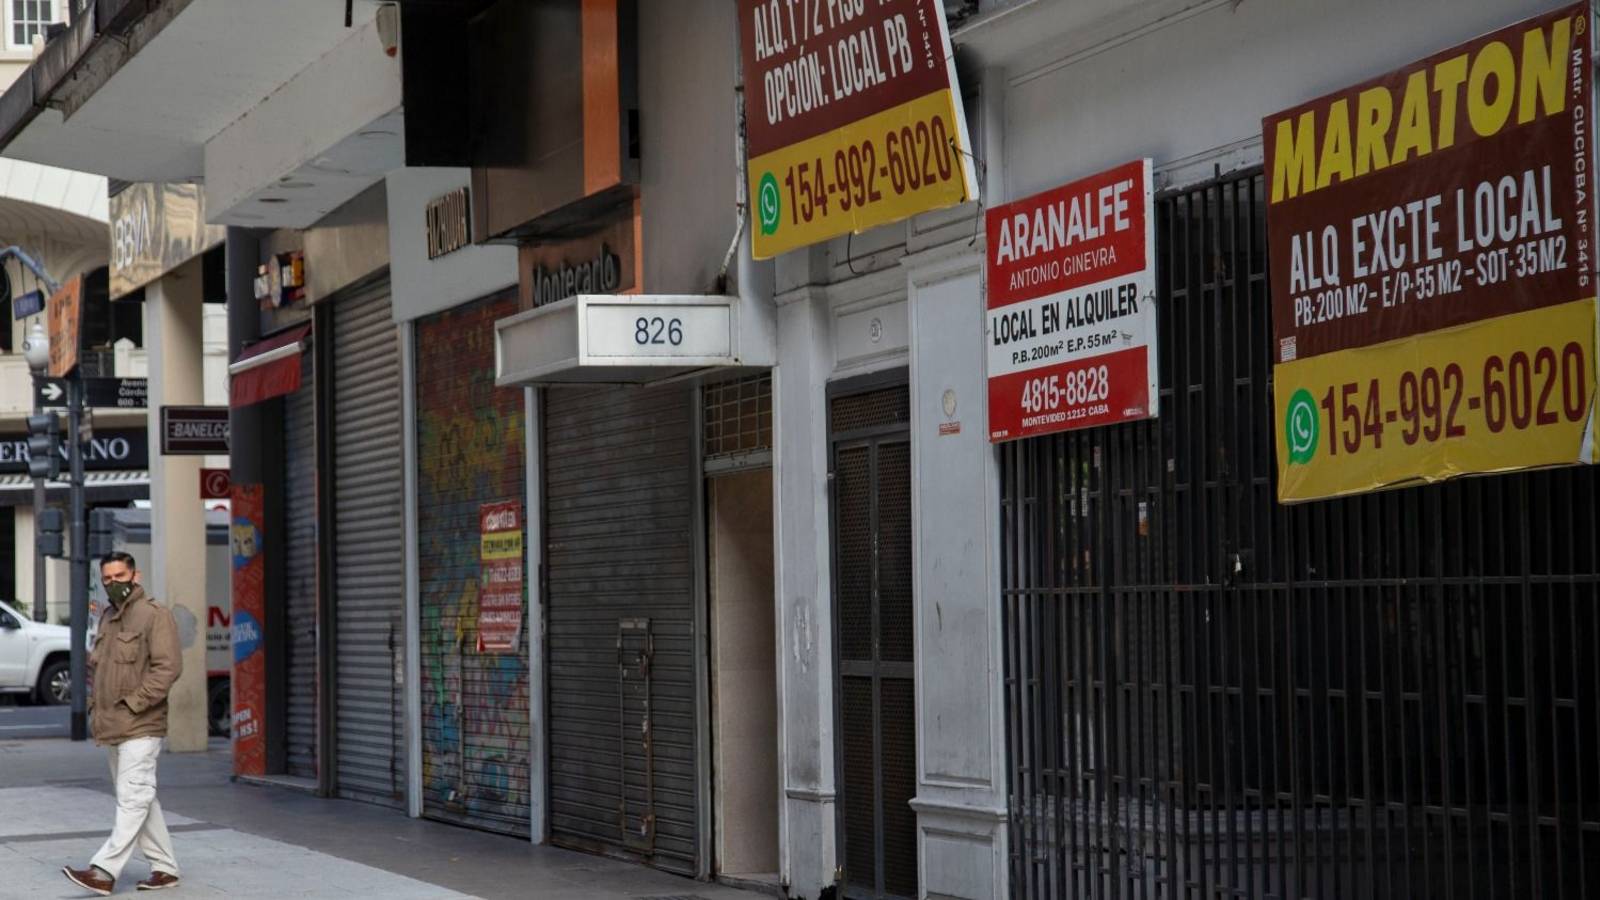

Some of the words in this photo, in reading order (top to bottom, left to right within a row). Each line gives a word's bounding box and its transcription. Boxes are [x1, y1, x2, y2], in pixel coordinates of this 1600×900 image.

[764, 45, 829, 125] OPCIÓN:
[828, 26, 886, 101] LOCAL
[883, 14, 913, 78] PB
[1573, 48, 1583, 98] Matr.
[1271, 17, 1571, 204] MARATON
[785, 115, 952, 225] 154-992-6020
[1573, 105, 1586, 204] CUCICBA
[1289, 225, 1341, 294] ALQ
[1352, 193, 1442, 279] EXCTE
[1457, 165, 1562, 254] LOCAL
[1009, 259, 1060, 291] ANTONIO
[1063, 245, 1117, 276] GINEVRA
[1577, 239, 1589, 287] 3415
[635, 317, 683, 346] 826
[993, 308, 1036, 345] LOCAL
[1041, 302, 1060, 335] EN
[1065, 282, 1138, 331] ALQUILER
[1021, 365, 1109, 413] 4815-8828
[1022, 412, 1066, 428] MONTEVIDEO
[1066, 407, 1087, 421] 1212
[1088, 403, 1110, 417] CABA
[1321, 341, 1586, 456] 154-992-6020
